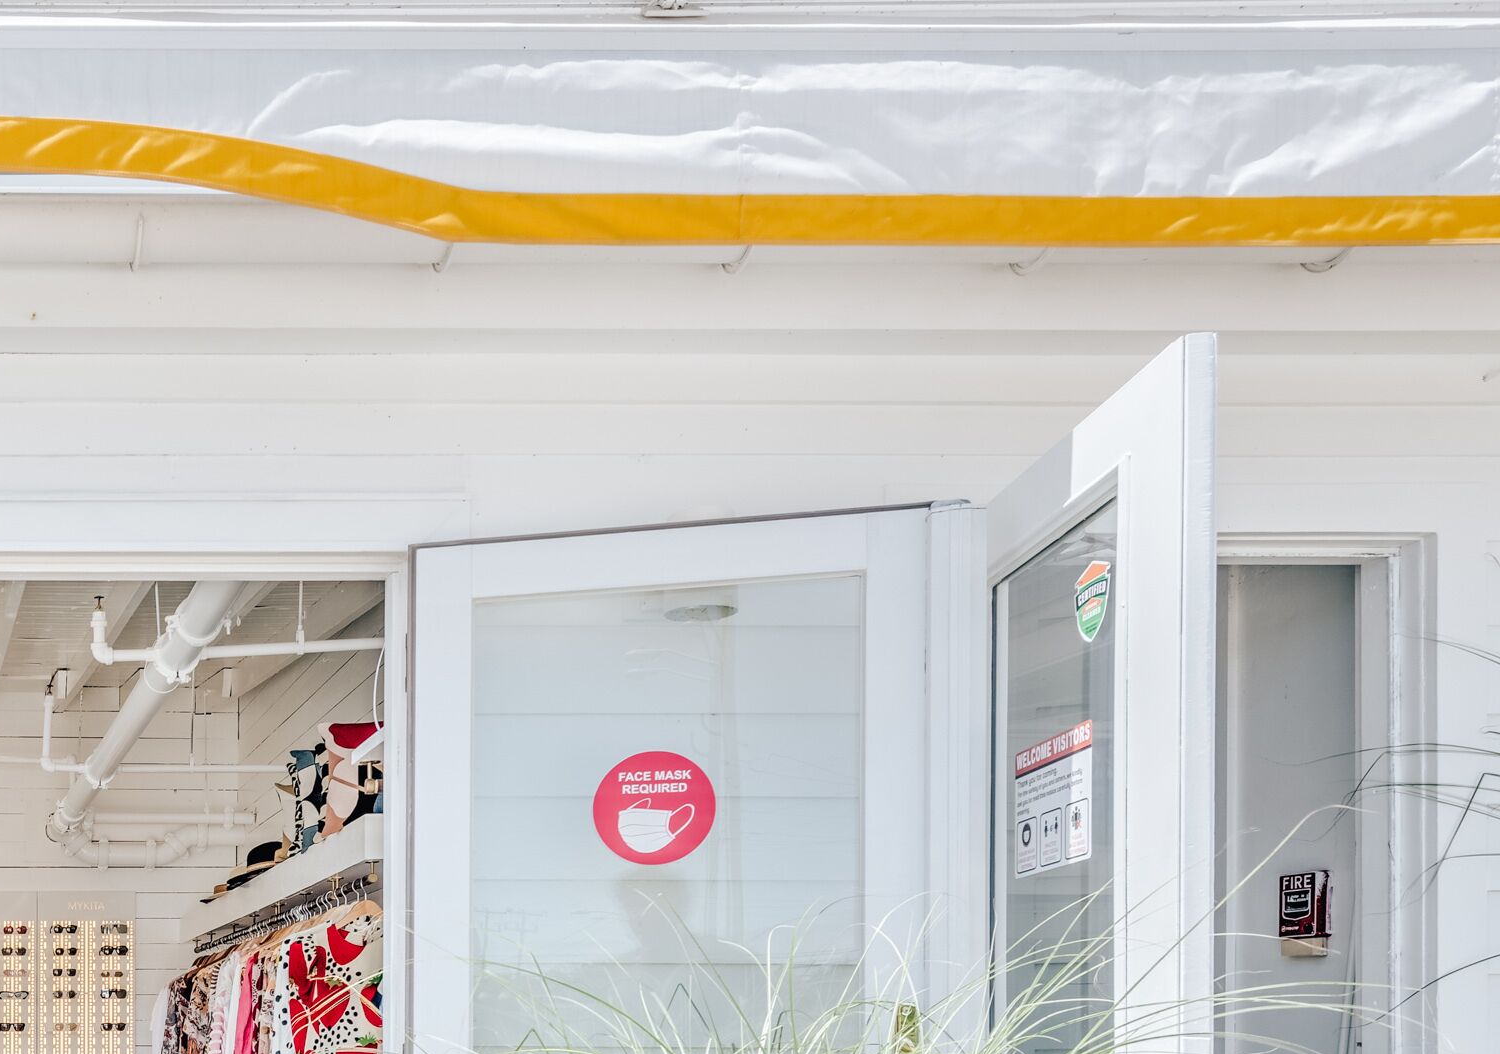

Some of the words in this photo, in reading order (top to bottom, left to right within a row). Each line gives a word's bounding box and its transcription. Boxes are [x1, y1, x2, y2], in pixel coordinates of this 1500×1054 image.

[1078, 580, 1106, 607] CERTIFIED
[1016, 741, 1051, 770] WELCOME
[1052, 723, 1090, 754] VISITORS
[618, 771, 651, 782] FACE
[654, 769, 692, 781] MASK
[622, 782, 687, 795] REQUIRED
[1282, 874, 1312, 890] FIRE
[67, 901, 106, 911] MYKITA
